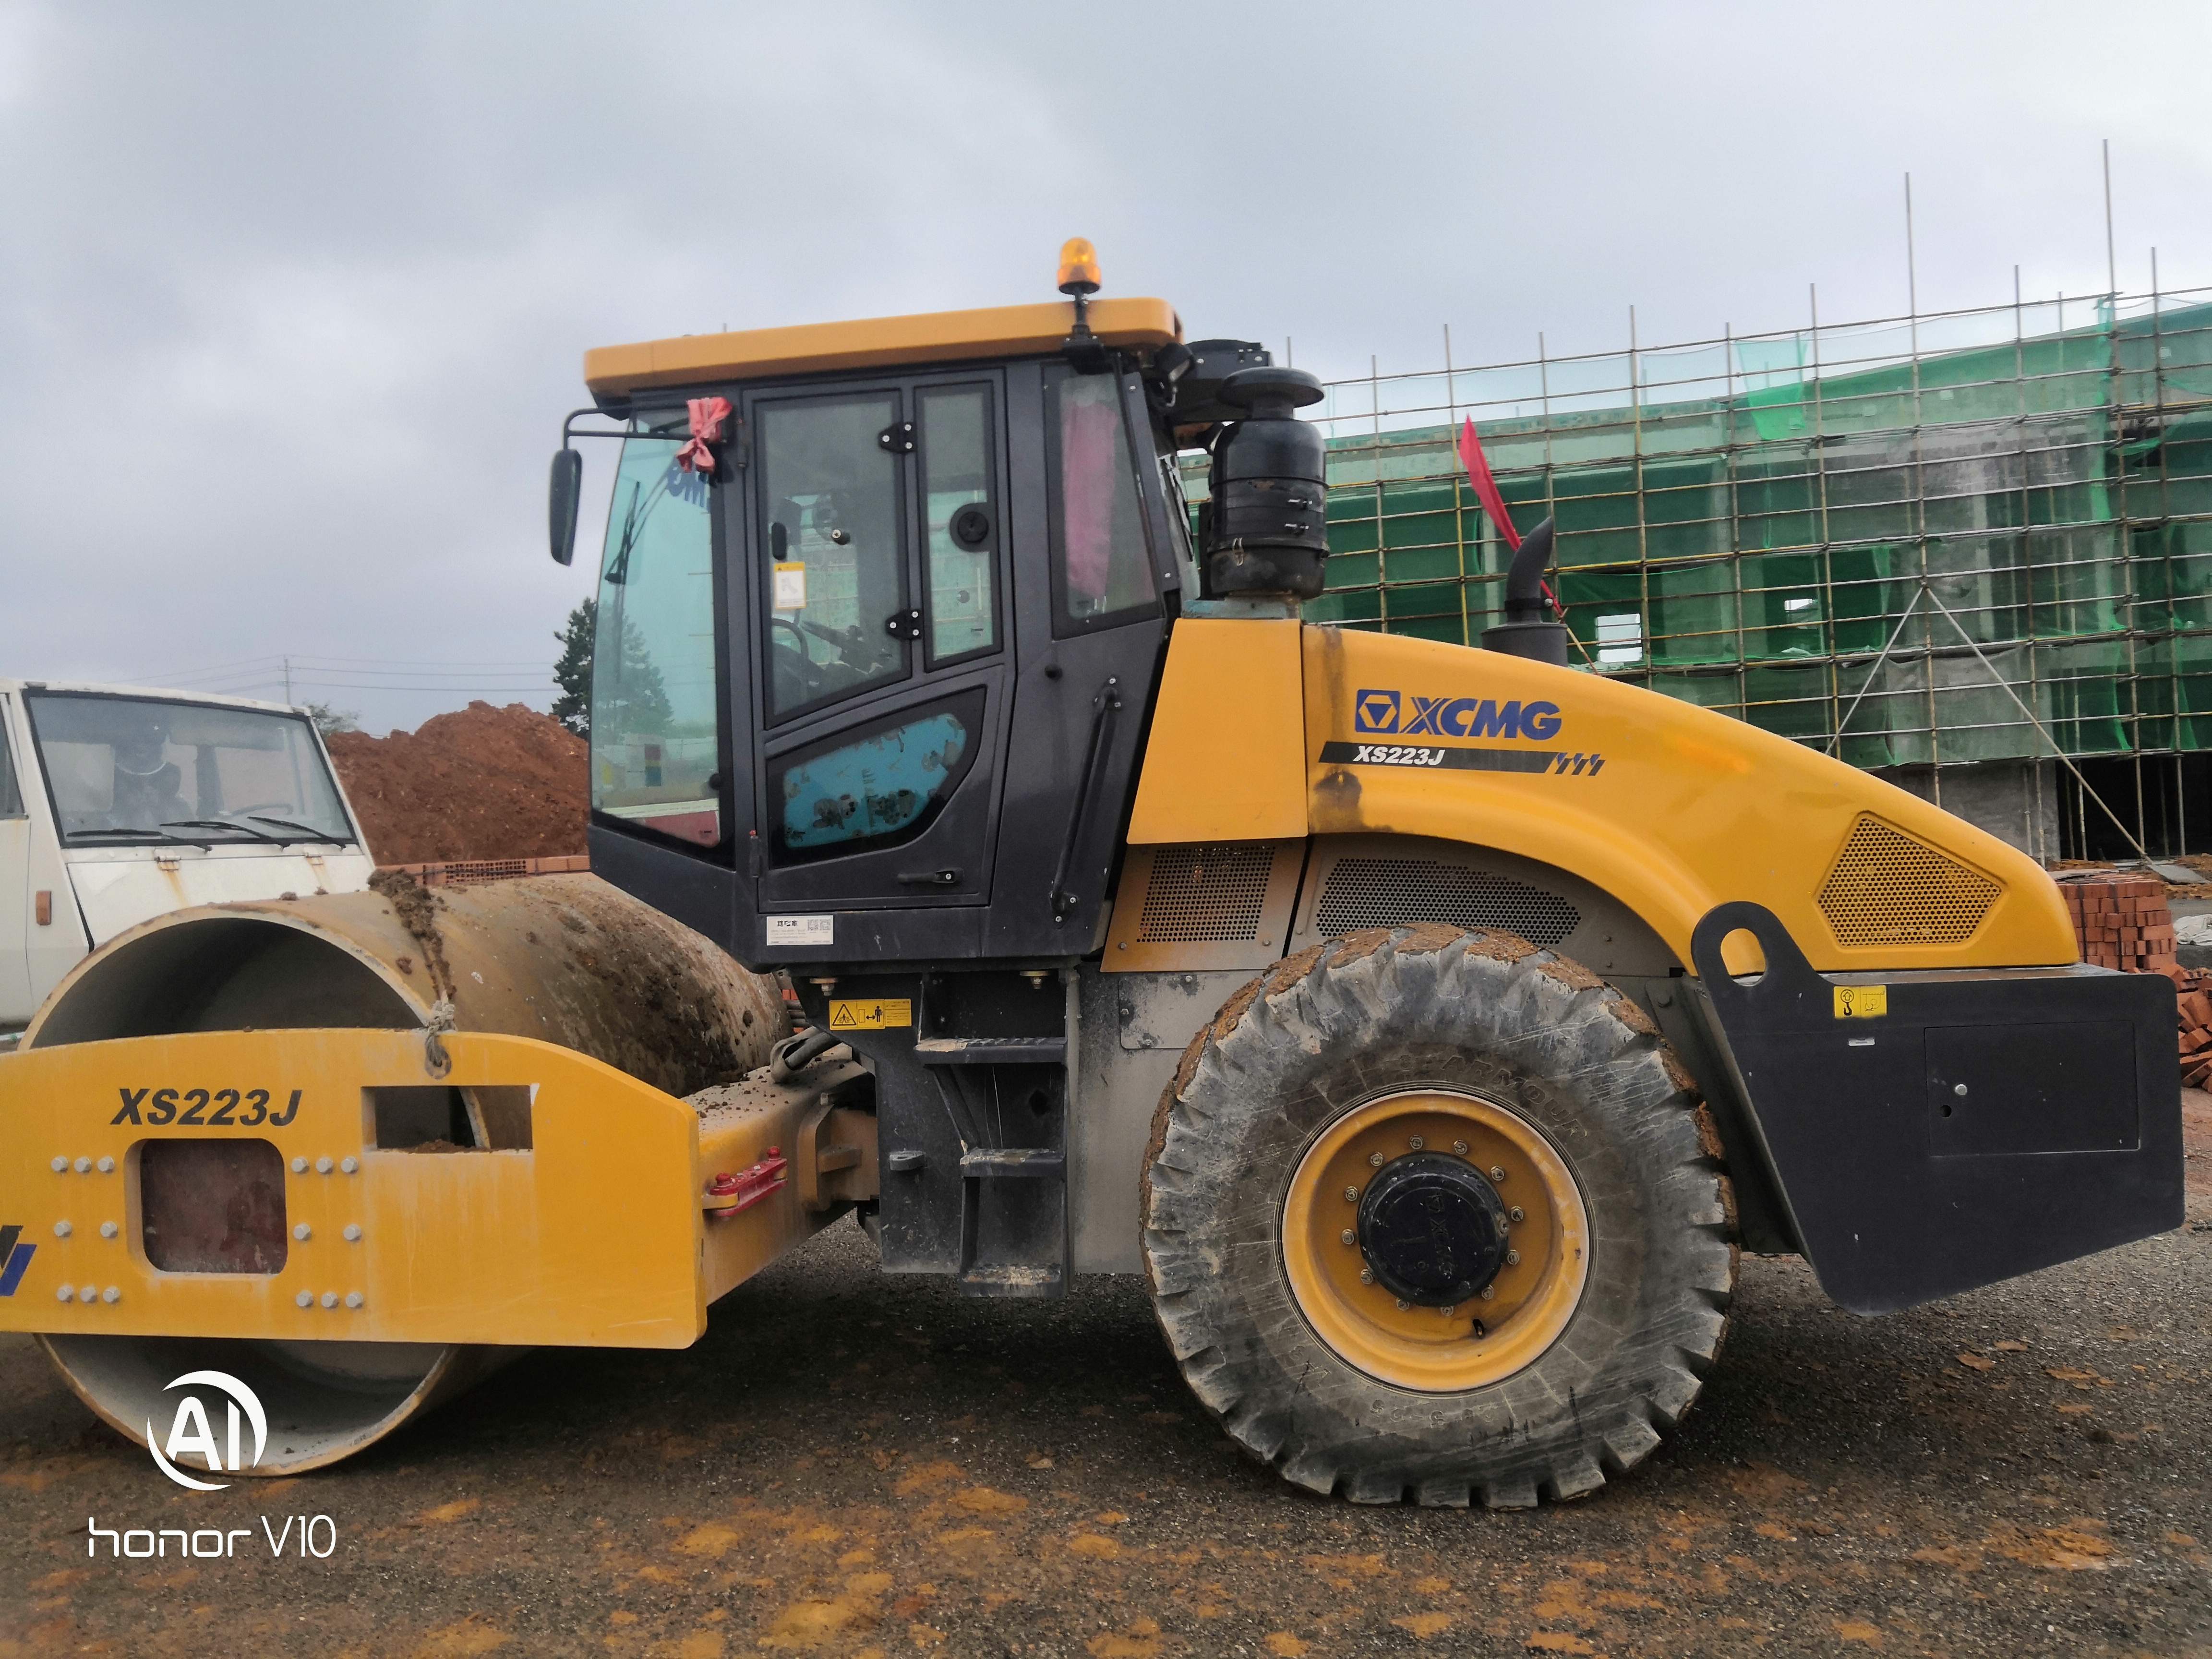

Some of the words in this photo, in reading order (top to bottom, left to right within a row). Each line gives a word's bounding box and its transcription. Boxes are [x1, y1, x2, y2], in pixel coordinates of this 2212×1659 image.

[1399, 697, 1562, 740] XCMG
[1353, 745, 1445, 766] XS223J
[110, 1088, 302, 1126] XS223J
[1441, 1055, 1587, 1137] ARMOUR
